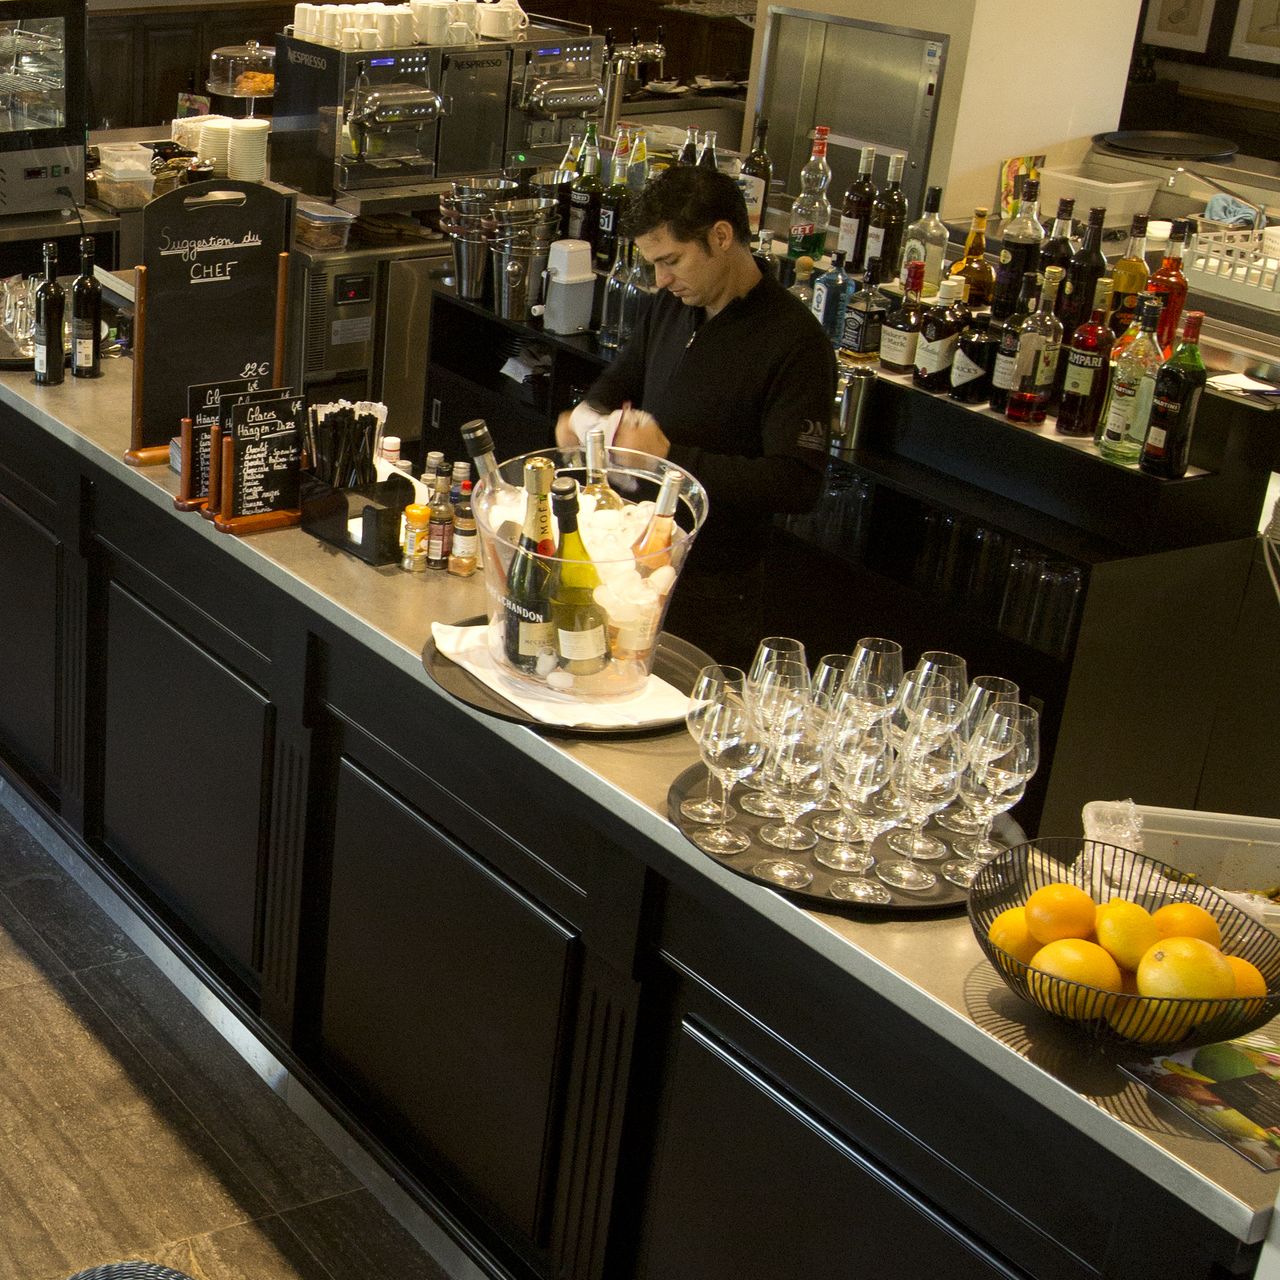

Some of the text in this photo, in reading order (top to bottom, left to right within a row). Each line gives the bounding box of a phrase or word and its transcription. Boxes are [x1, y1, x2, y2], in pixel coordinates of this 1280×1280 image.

[158, 226, 262, 262] Suggestion du
[190, 261, 238, 279] CHEF
[1069, 351, 1103, 368] AMPARI
[246, 406, 278, 423] Glaces
[502, 597, 544, 623] CHANDON
